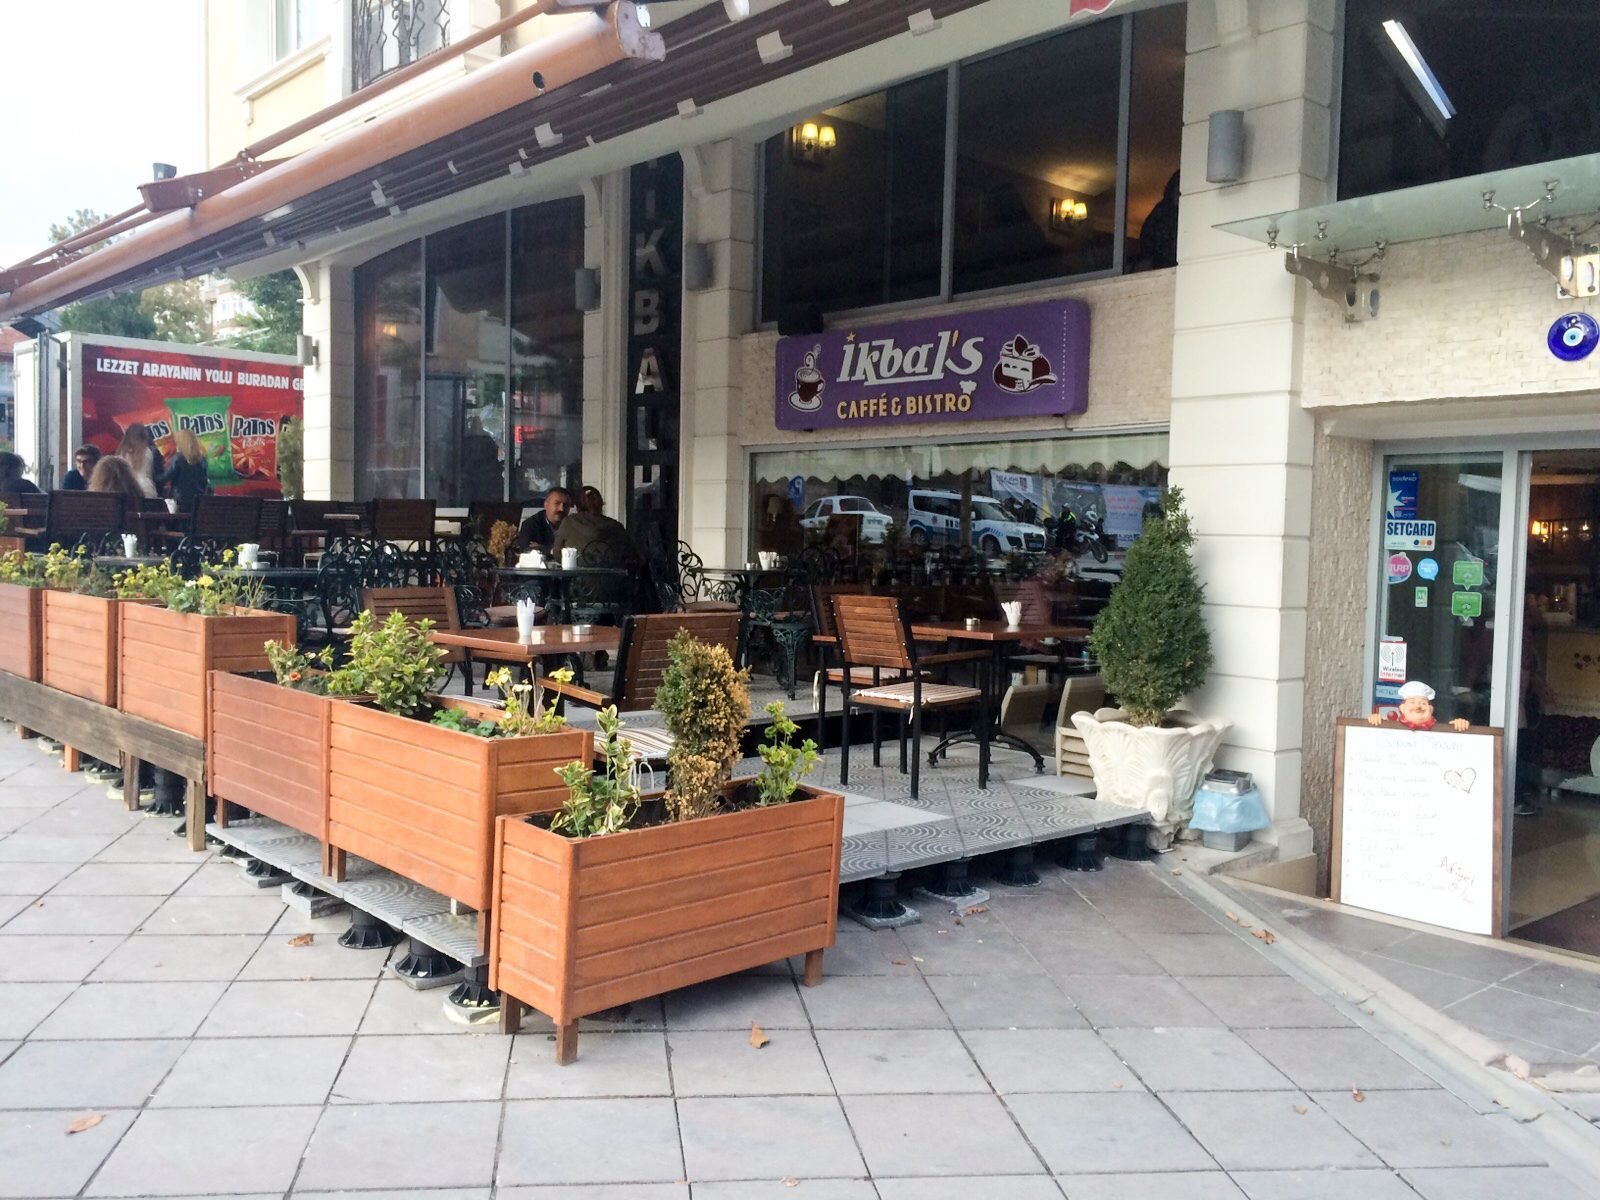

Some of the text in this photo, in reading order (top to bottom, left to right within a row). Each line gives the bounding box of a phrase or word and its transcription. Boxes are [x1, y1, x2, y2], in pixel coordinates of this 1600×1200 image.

[96, 357, 140, 376] LEZZET
[142, 362, 202, 381] ARAYANIN
[204, 368, 233, 385] YOLU
[237, 371, 290, 390] BURADAN
[836, 392, 972, 420] CAFFÉ & BISTRO
[1386, 521, 1435, 537] SETCARD
